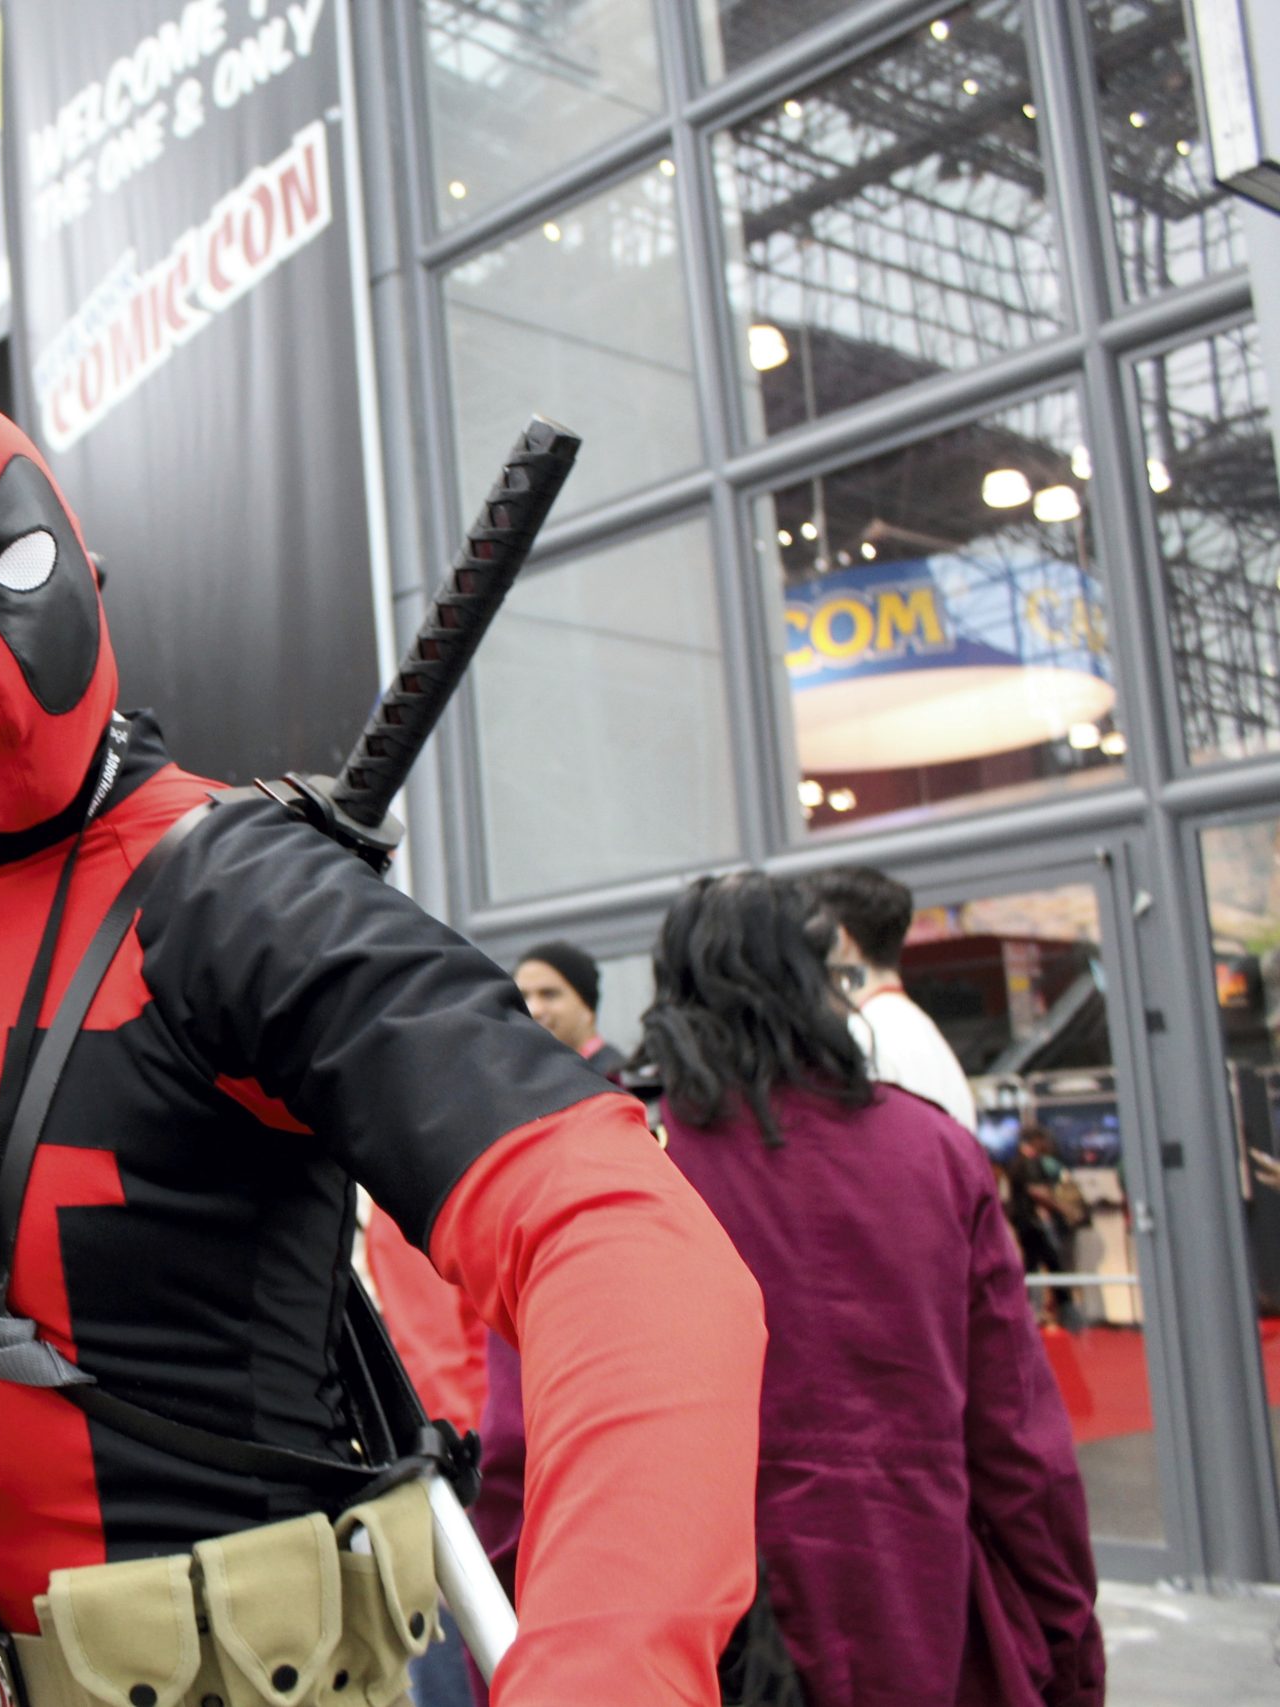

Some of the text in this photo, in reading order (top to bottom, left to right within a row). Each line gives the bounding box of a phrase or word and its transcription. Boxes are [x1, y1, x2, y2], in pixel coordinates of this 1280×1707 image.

[29, 0, 227, 186] WELCOME
[98, 101, 168, 192] ONE
[172, 77, 205, 138] &
[213, 0, 322, 109] ONLY
[50, 250, 192, 436] COMIC
[206, 142, 322, 294] CON
